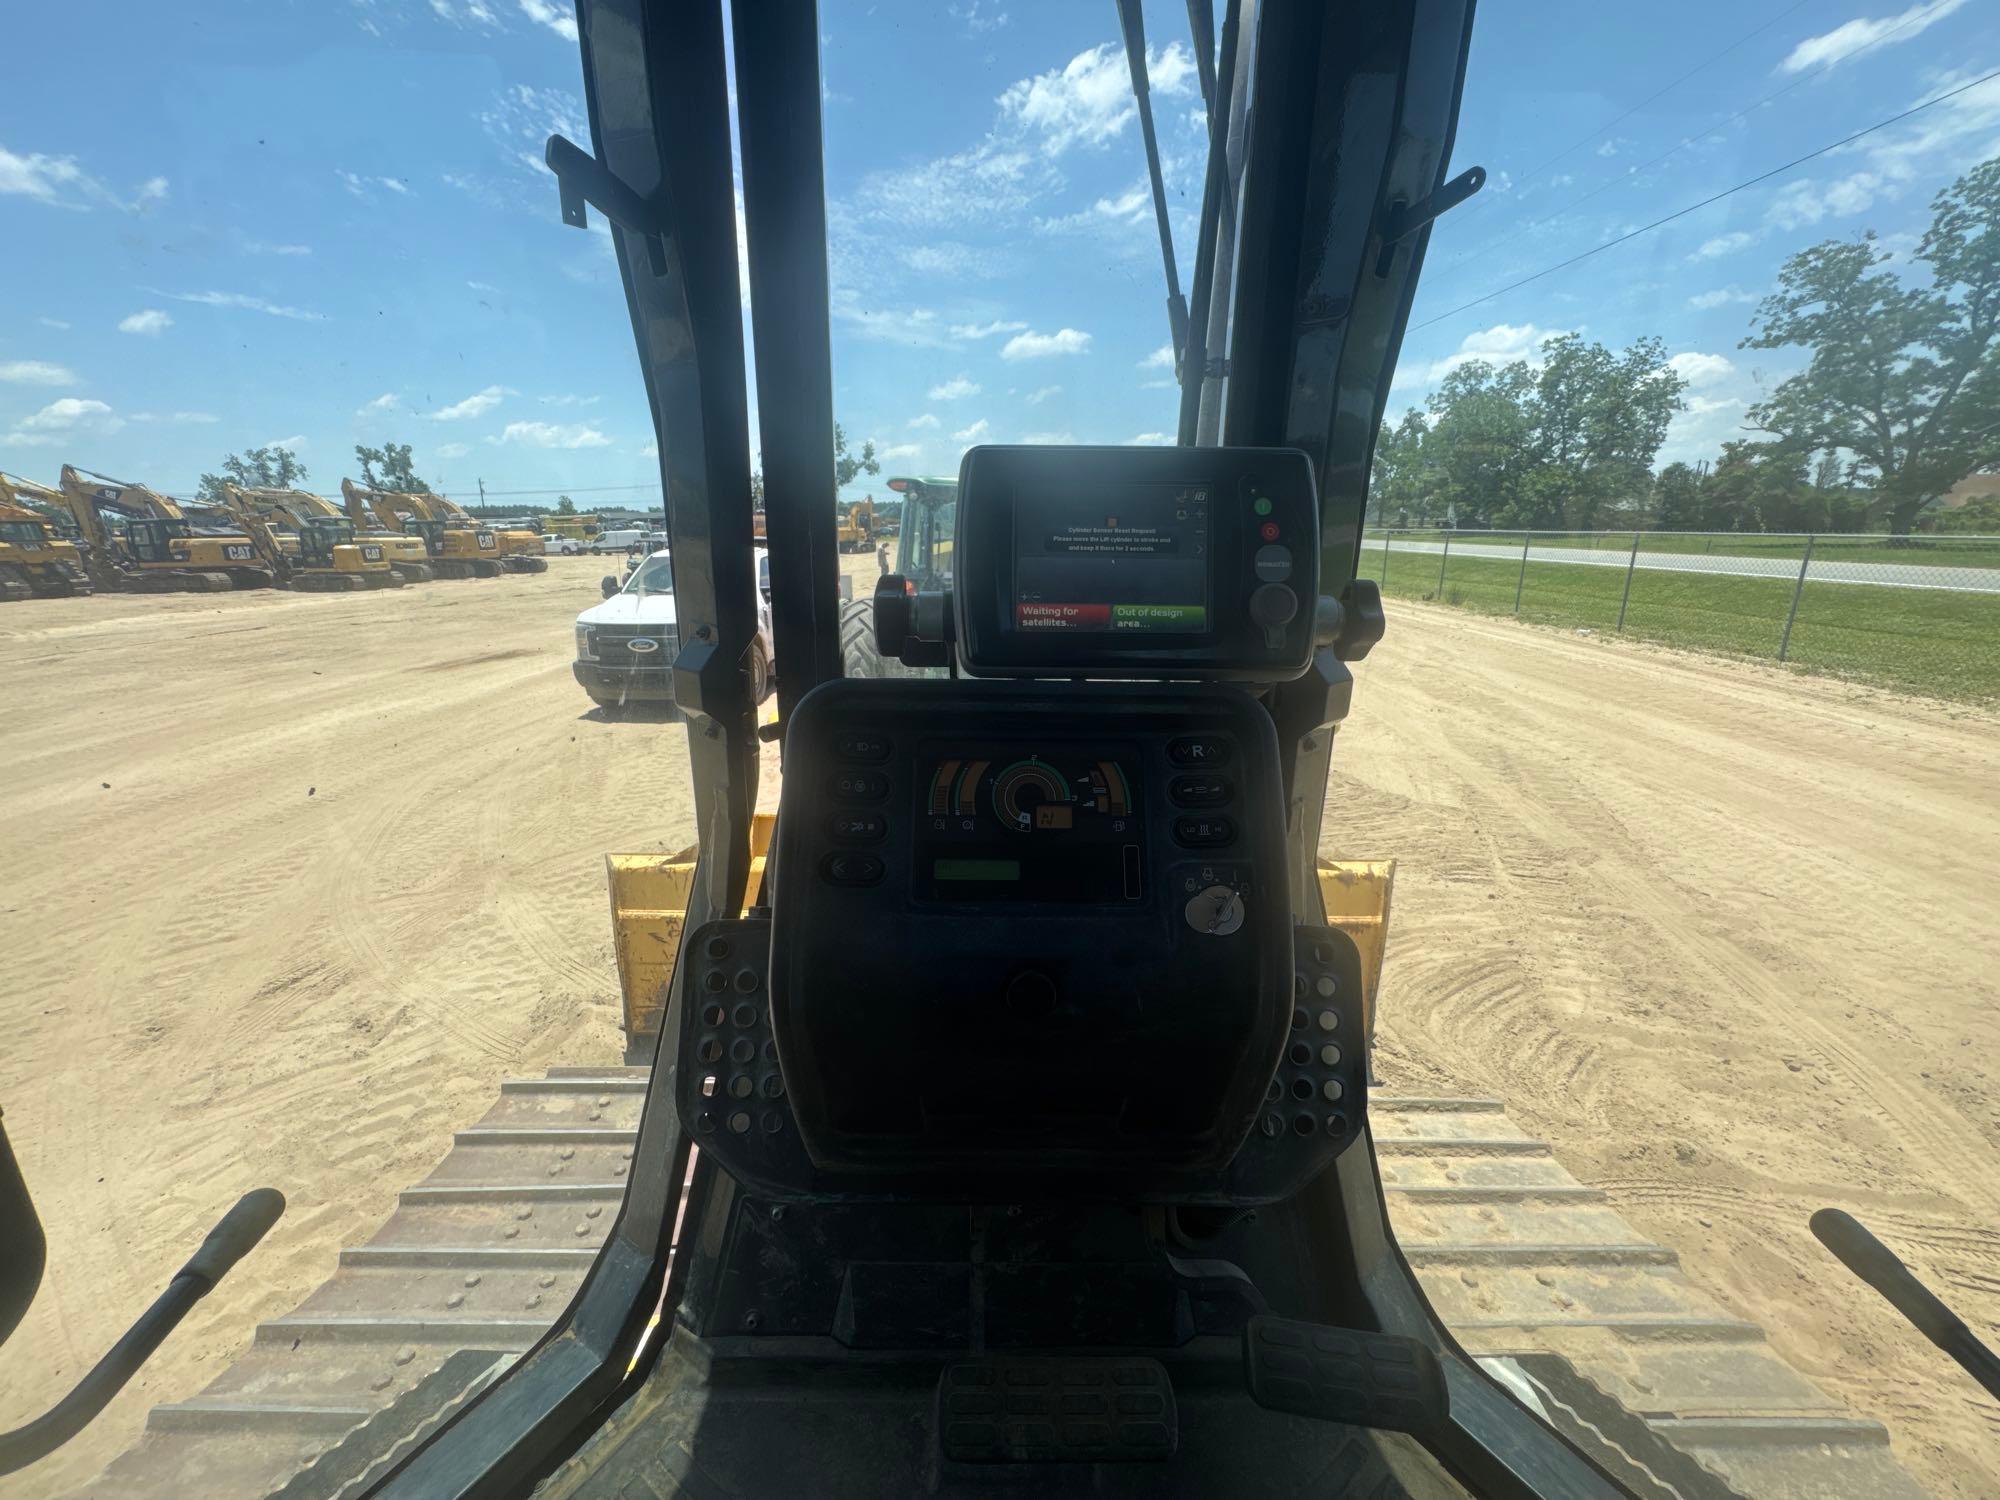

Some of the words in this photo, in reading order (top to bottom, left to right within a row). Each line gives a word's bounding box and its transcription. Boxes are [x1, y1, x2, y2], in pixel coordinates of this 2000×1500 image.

[478, 534, 494, 549] CAT
[227, 546, 251, 560] CAT
[365, 547, 380, 560] CAT
[1022, 606, 1061, 617] Waiting
[1062, 606, 1079, 617] for
[1117, 606, 1136, 617] Out
[1137, 606, 1149, 617] of
[1150, 606, 1183, 619] design
[1022, 617, 1077, 628] satellites...
[1117, 619, 1150, 629] area...
[633, 640, 655, 650] Ford
[1192, 744, 1204, 758] R
